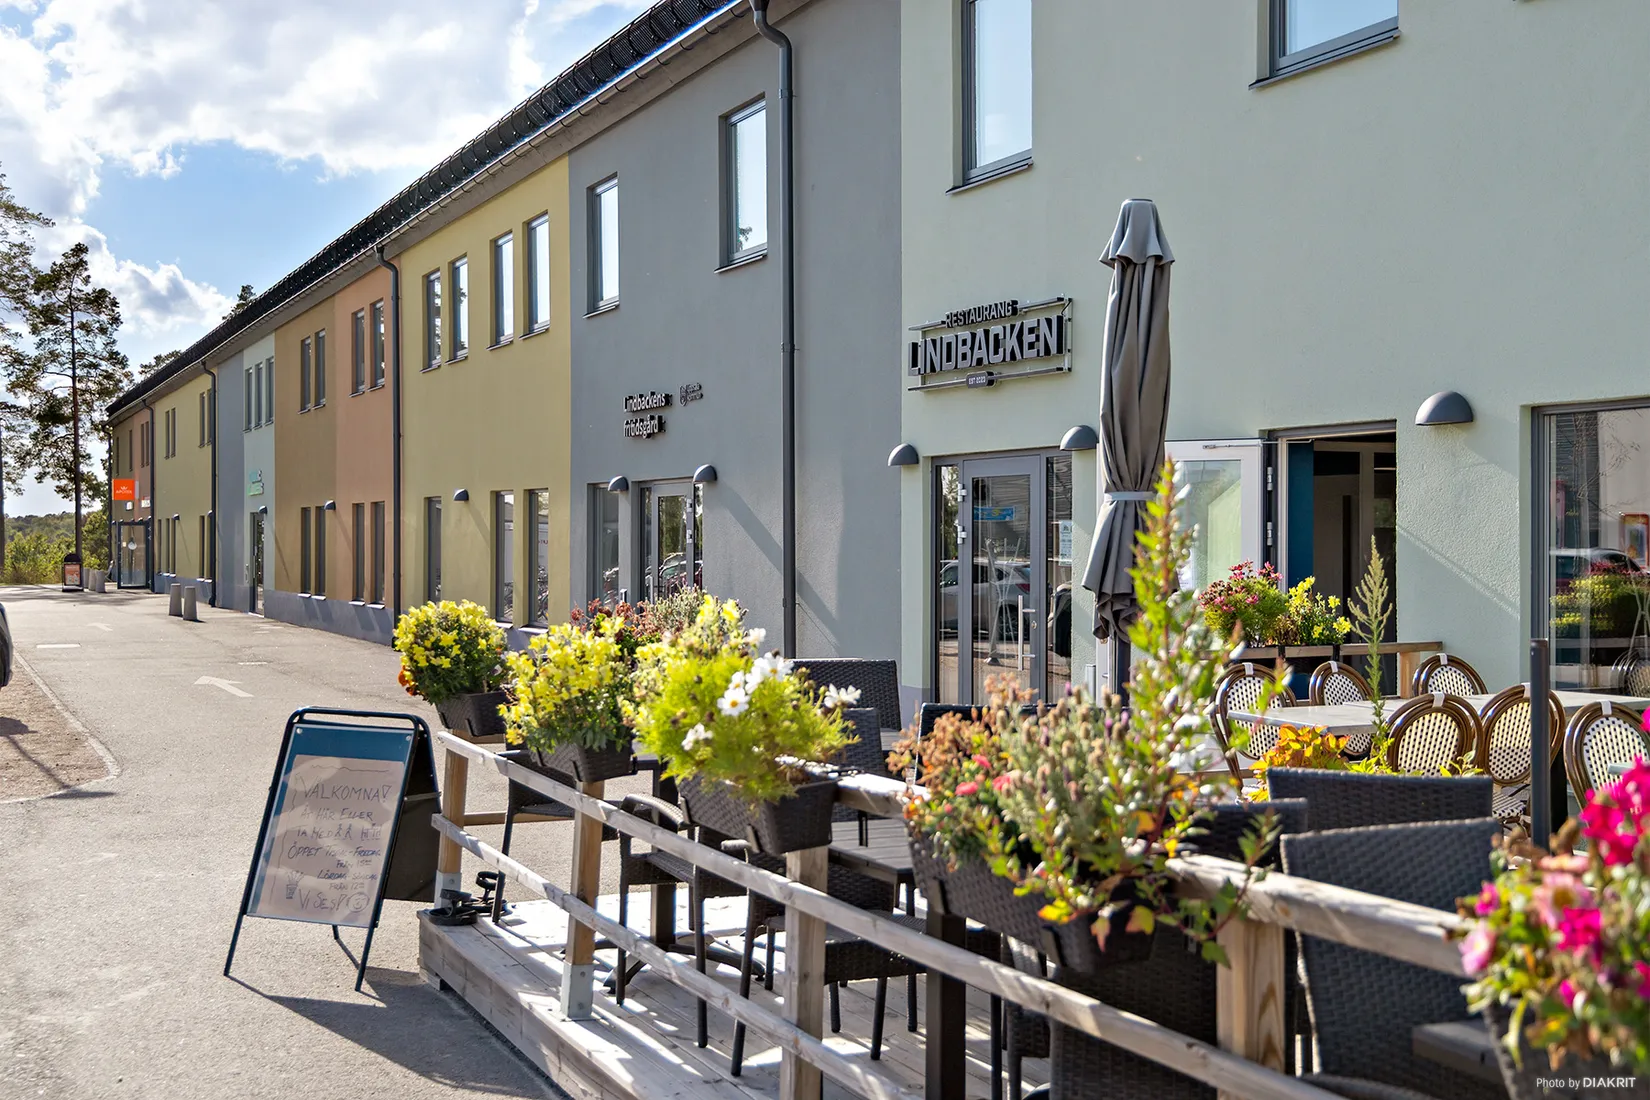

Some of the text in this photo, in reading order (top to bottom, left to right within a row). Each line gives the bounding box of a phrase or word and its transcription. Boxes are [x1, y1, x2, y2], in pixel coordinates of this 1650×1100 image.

[945, 300, 1012, 328] RESTAURANG
[908, 314, 1064, 376] LINDBACKEN
[287, 841, 323, 859] ÖPPET
